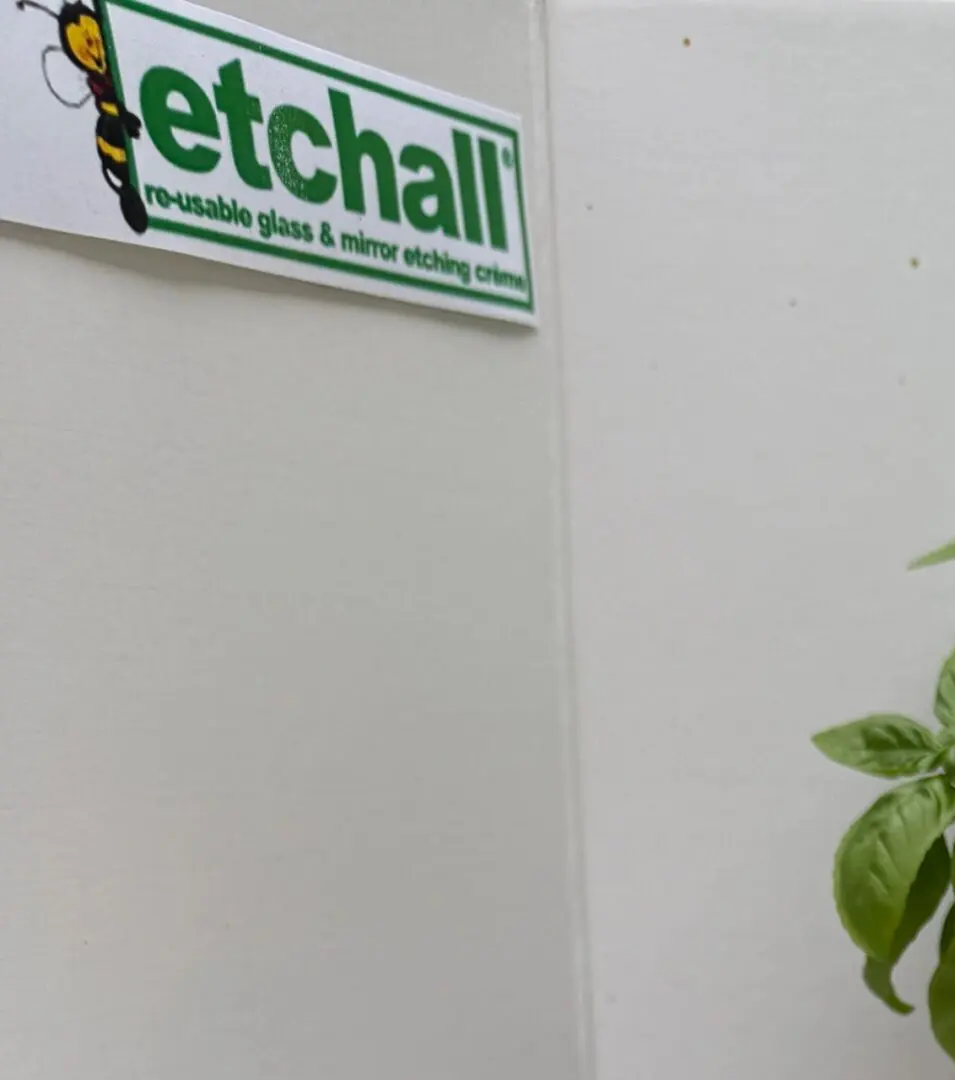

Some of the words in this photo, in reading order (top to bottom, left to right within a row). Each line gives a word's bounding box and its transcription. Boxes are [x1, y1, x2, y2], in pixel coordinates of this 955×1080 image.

[139, 58, 508, 253] etchall
[144, 183, 253, 229] re-usable
[257, 208, 314, 240] glass
[319, 221, 336, 248] &
[340, 229, 399, 263] mirror
[403, 244, 471, 284] etching
